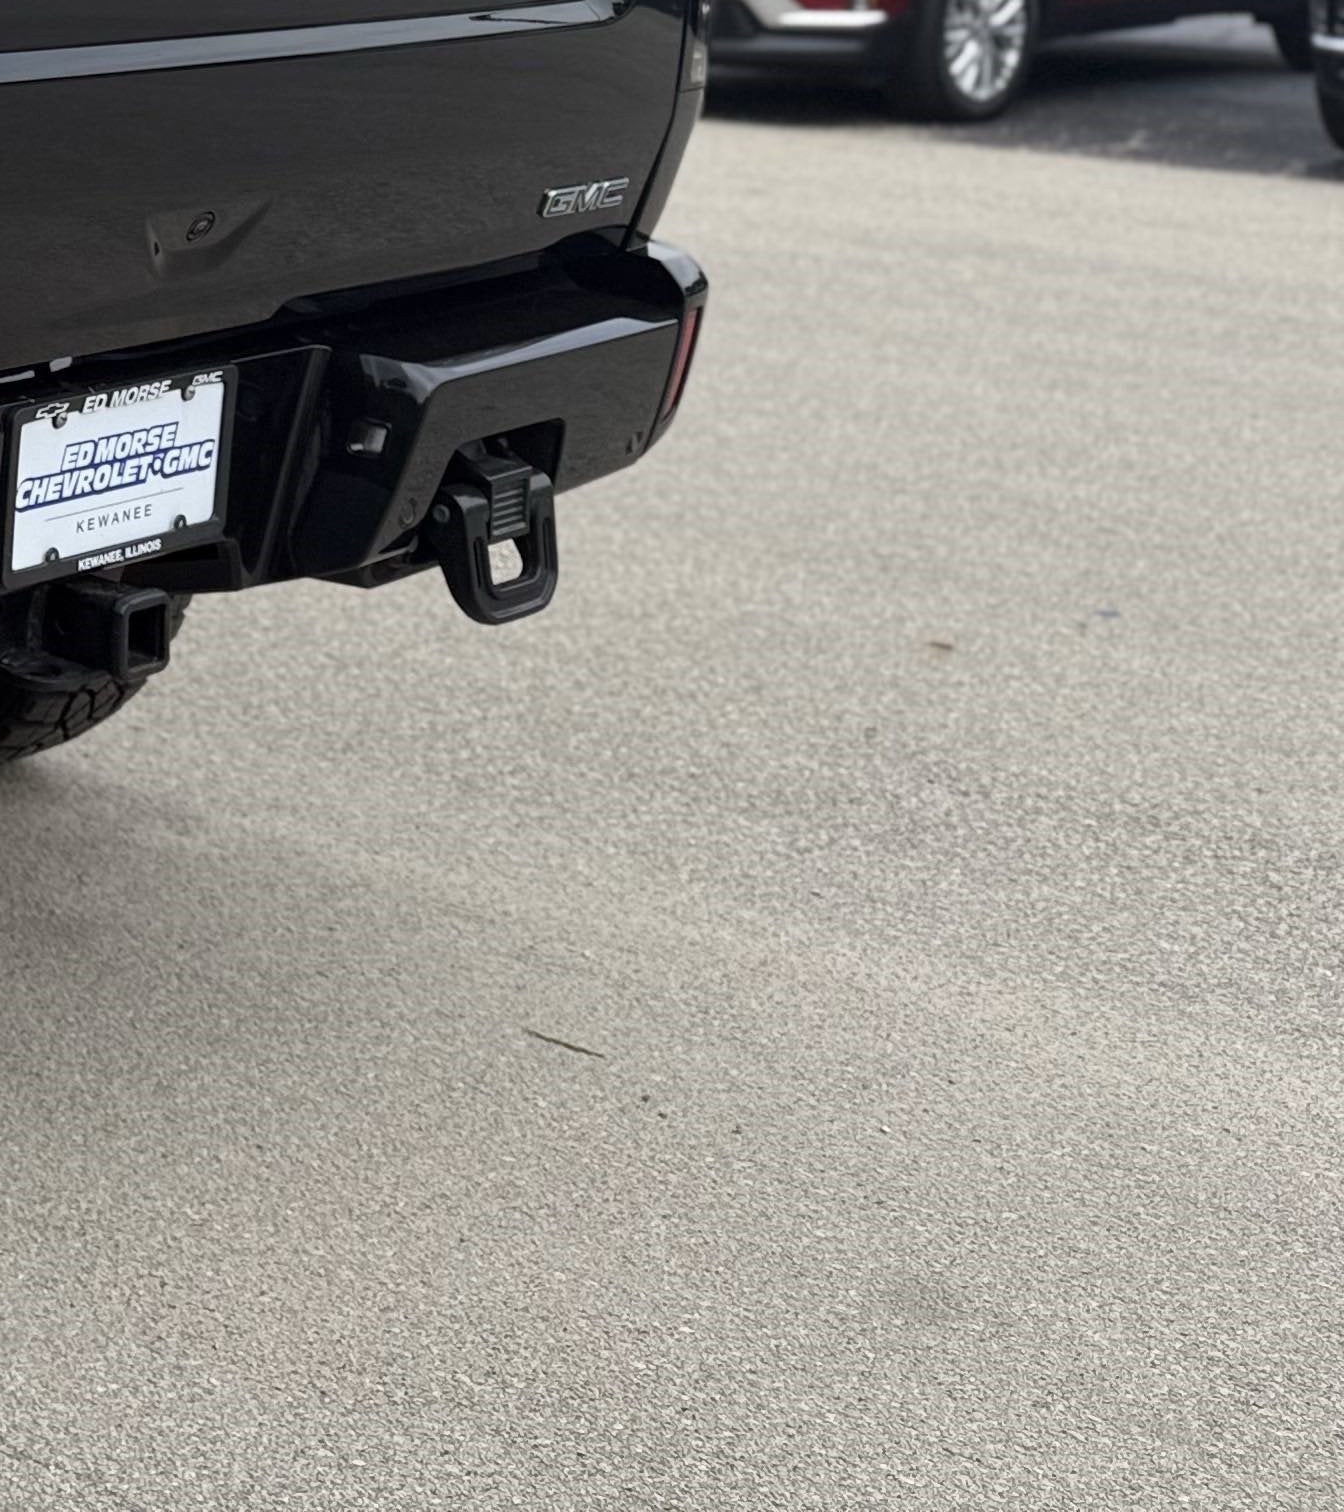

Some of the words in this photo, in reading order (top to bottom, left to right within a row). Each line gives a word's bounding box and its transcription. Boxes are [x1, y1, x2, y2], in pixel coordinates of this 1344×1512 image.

[542, 177, 630, 218] GMC
[82, 392, 108, 414] ED
[111, 379, 172, 408] MORSE
[192, 371, 224, 387] GMC
[62, 440, 96, 471] ED
[96, 422, 179, 464] MORSE
[75, 504, 153, 533] KEWANEE
[124, 538, 162, 560] ILLINOIS
